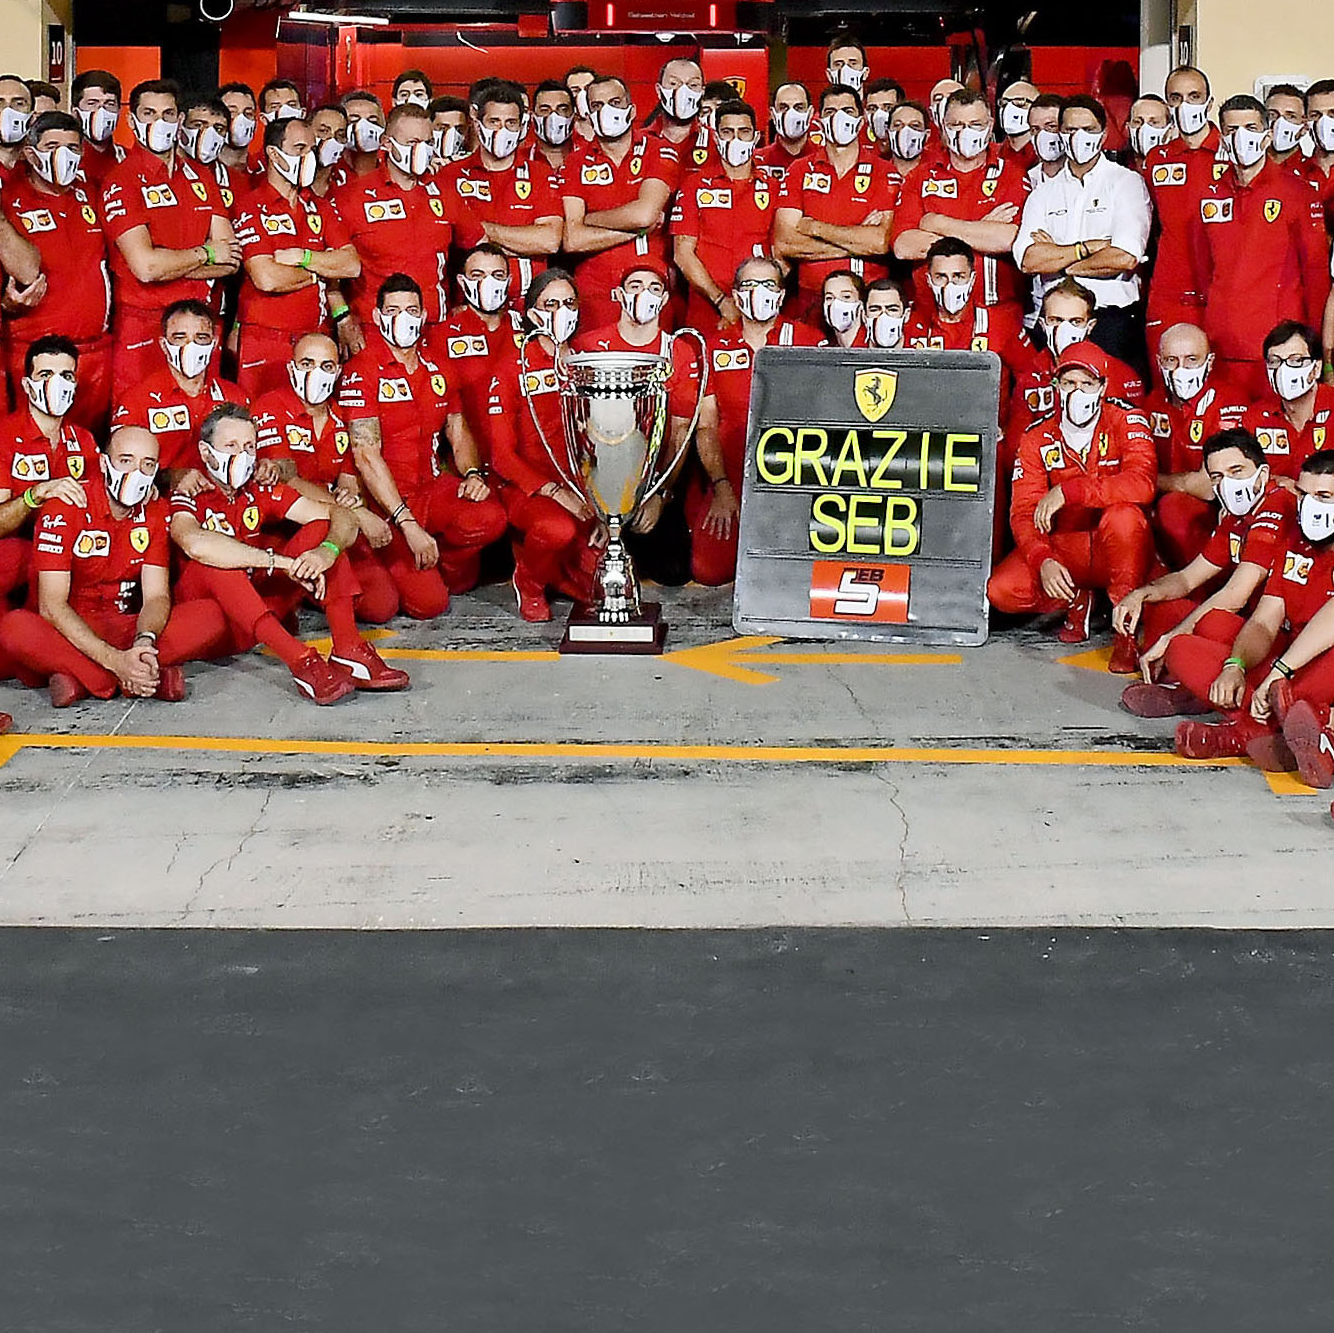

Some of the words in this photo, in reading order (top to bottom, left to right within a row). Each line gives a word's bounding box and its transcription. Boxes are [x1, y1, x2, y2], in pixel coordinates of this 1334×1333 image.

[51, 40, 63, 66] 10
[756, 427, 981, 492] GRAZIE
[809, 494, 921, 556] SEB
[833, 570, 881, 616] 5
